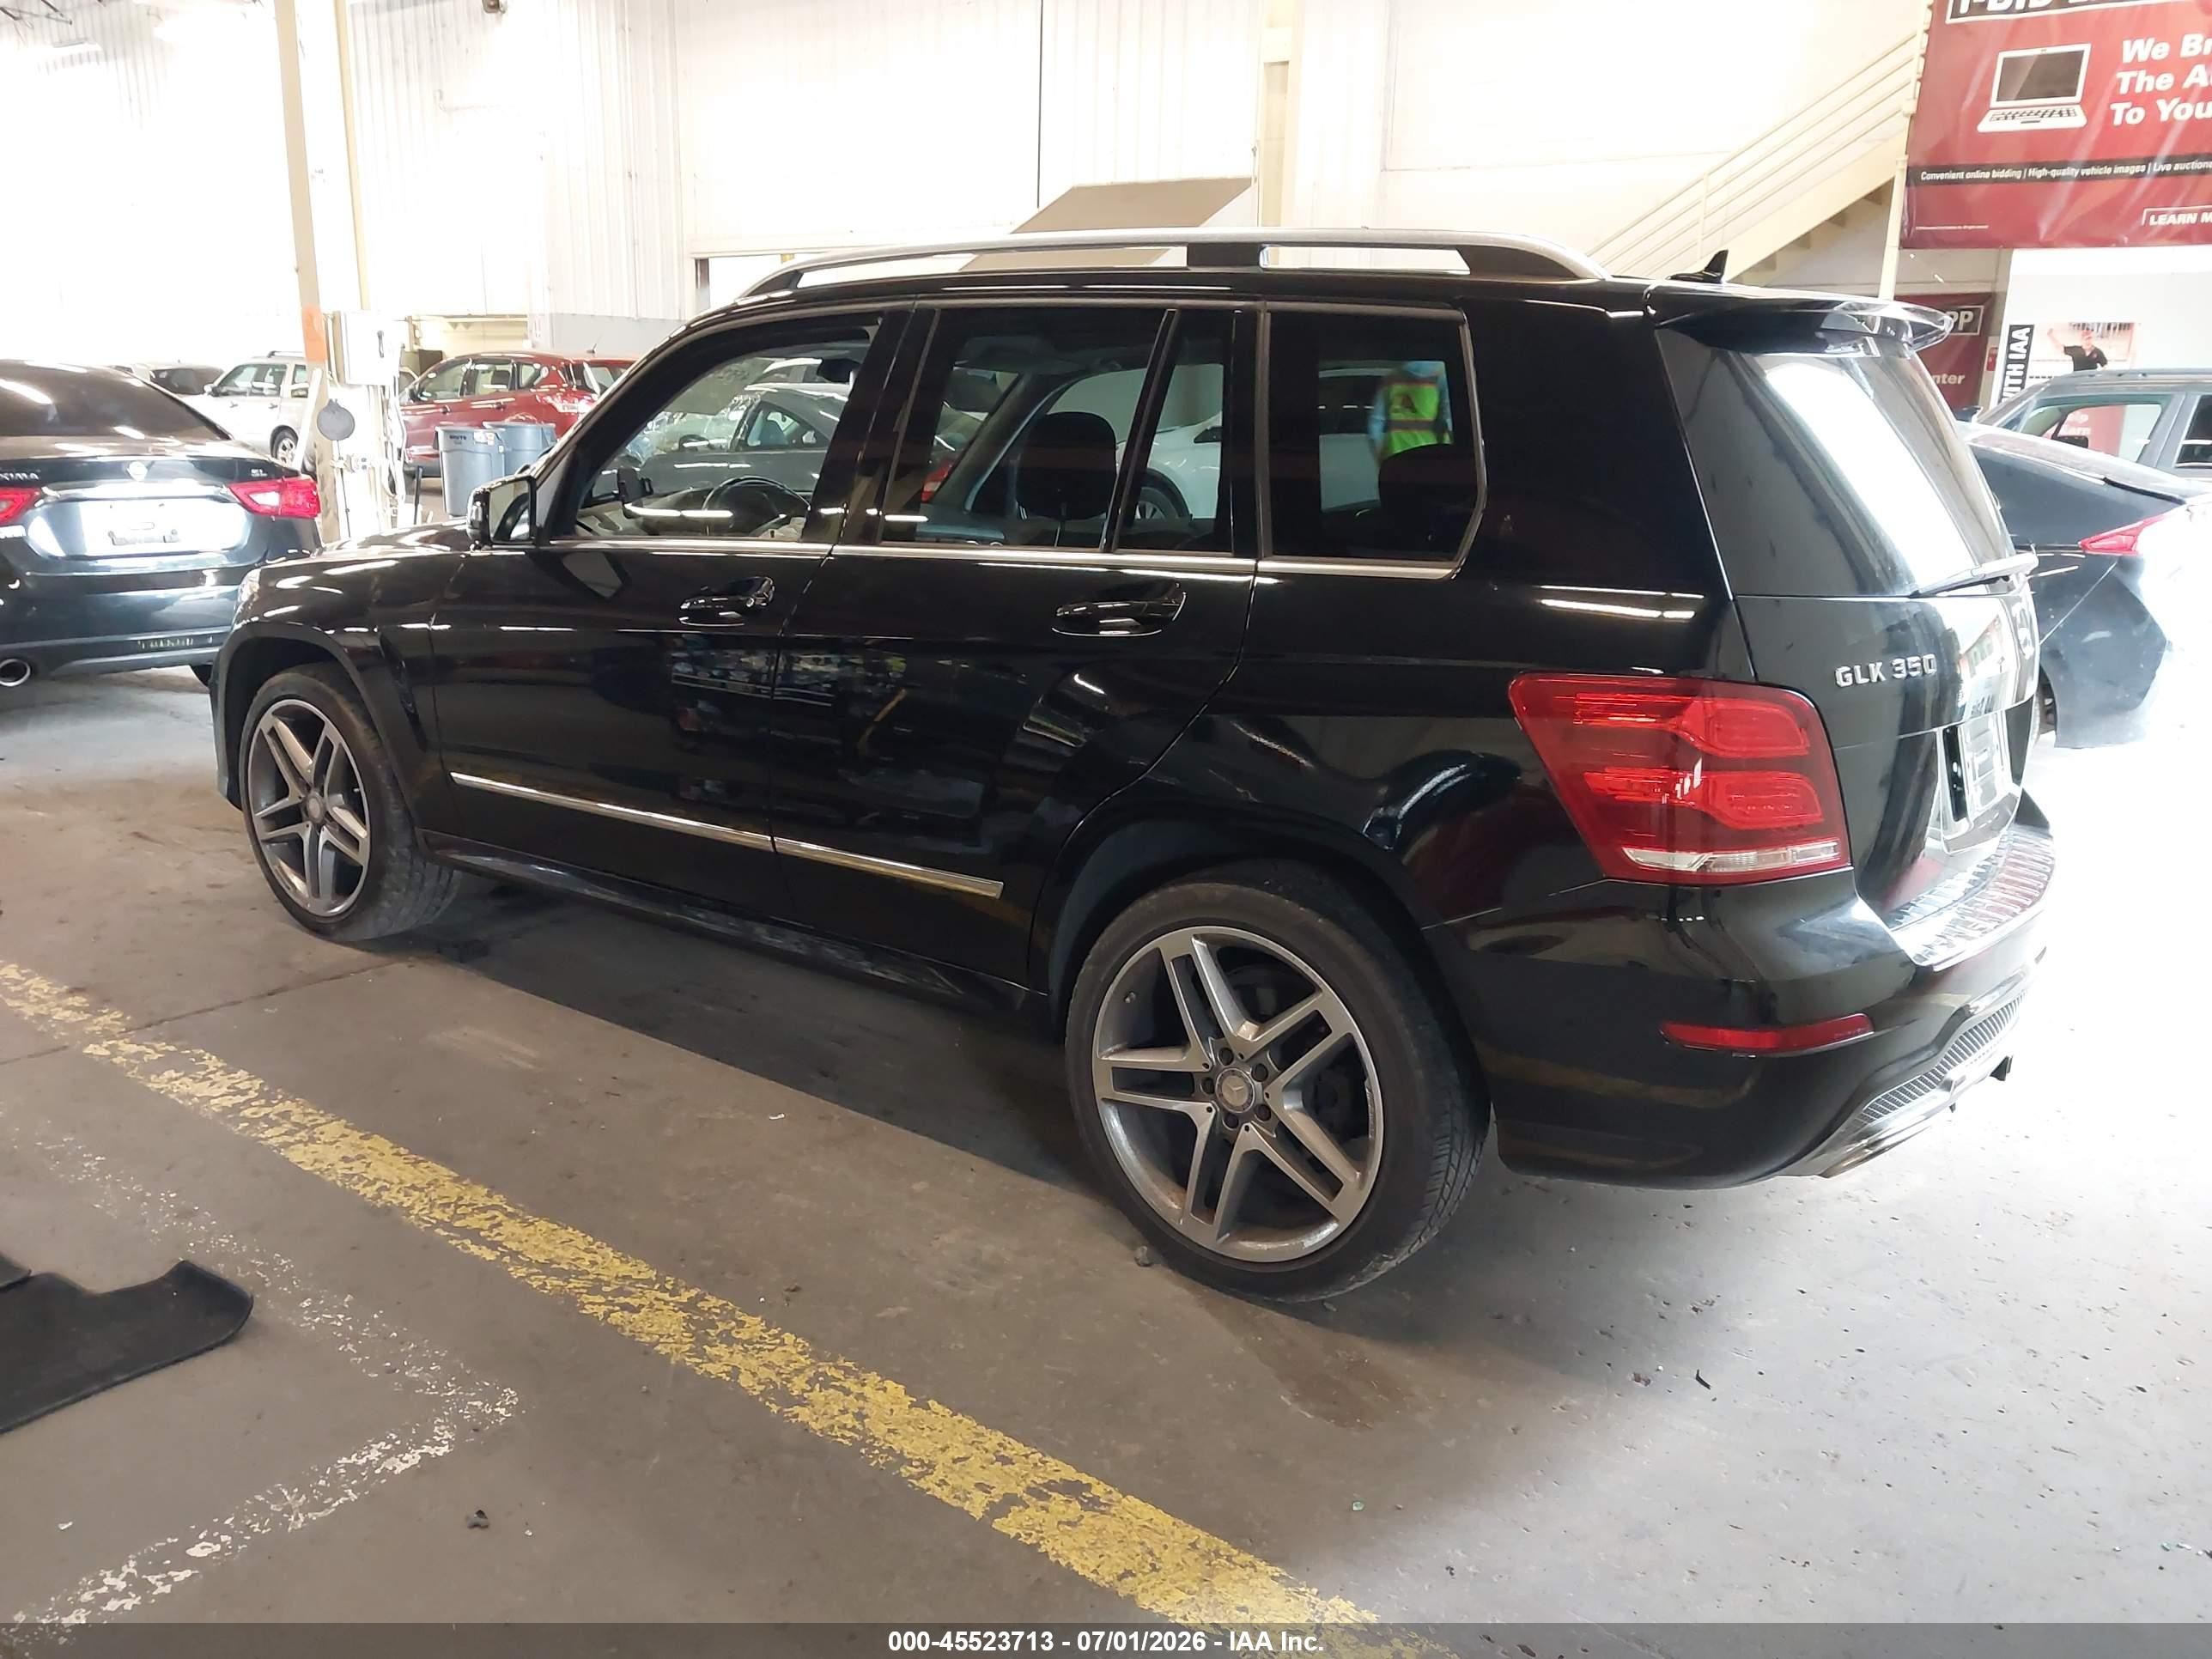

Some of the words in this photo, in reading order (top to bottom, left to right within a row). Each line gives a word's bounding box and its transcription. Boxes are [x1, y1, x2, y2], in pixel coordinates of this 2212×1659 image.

[2122, 37, 2170, 63] We
[2116, 70, 2174, 94] The
[2182, 64, 2212, 88] A
[2110, 101, 2145, 126] To
[1921, 170, 1964, 180] Convenient
[1966, 169, 1990, 179] online
[1991, 168, 2021, 179] bidding
[2081, 165, 2112, 175] vehicle
[2113, 164, 2146, 175] images
[2154, 161, 2172, 172] Live
[2149, 213, 2198, 226] LEARN
[2008, 327, 2030, 360] IAA
[1835, 662, 1887, 687] GLK
[1892, 653, 1937, 679] 350
